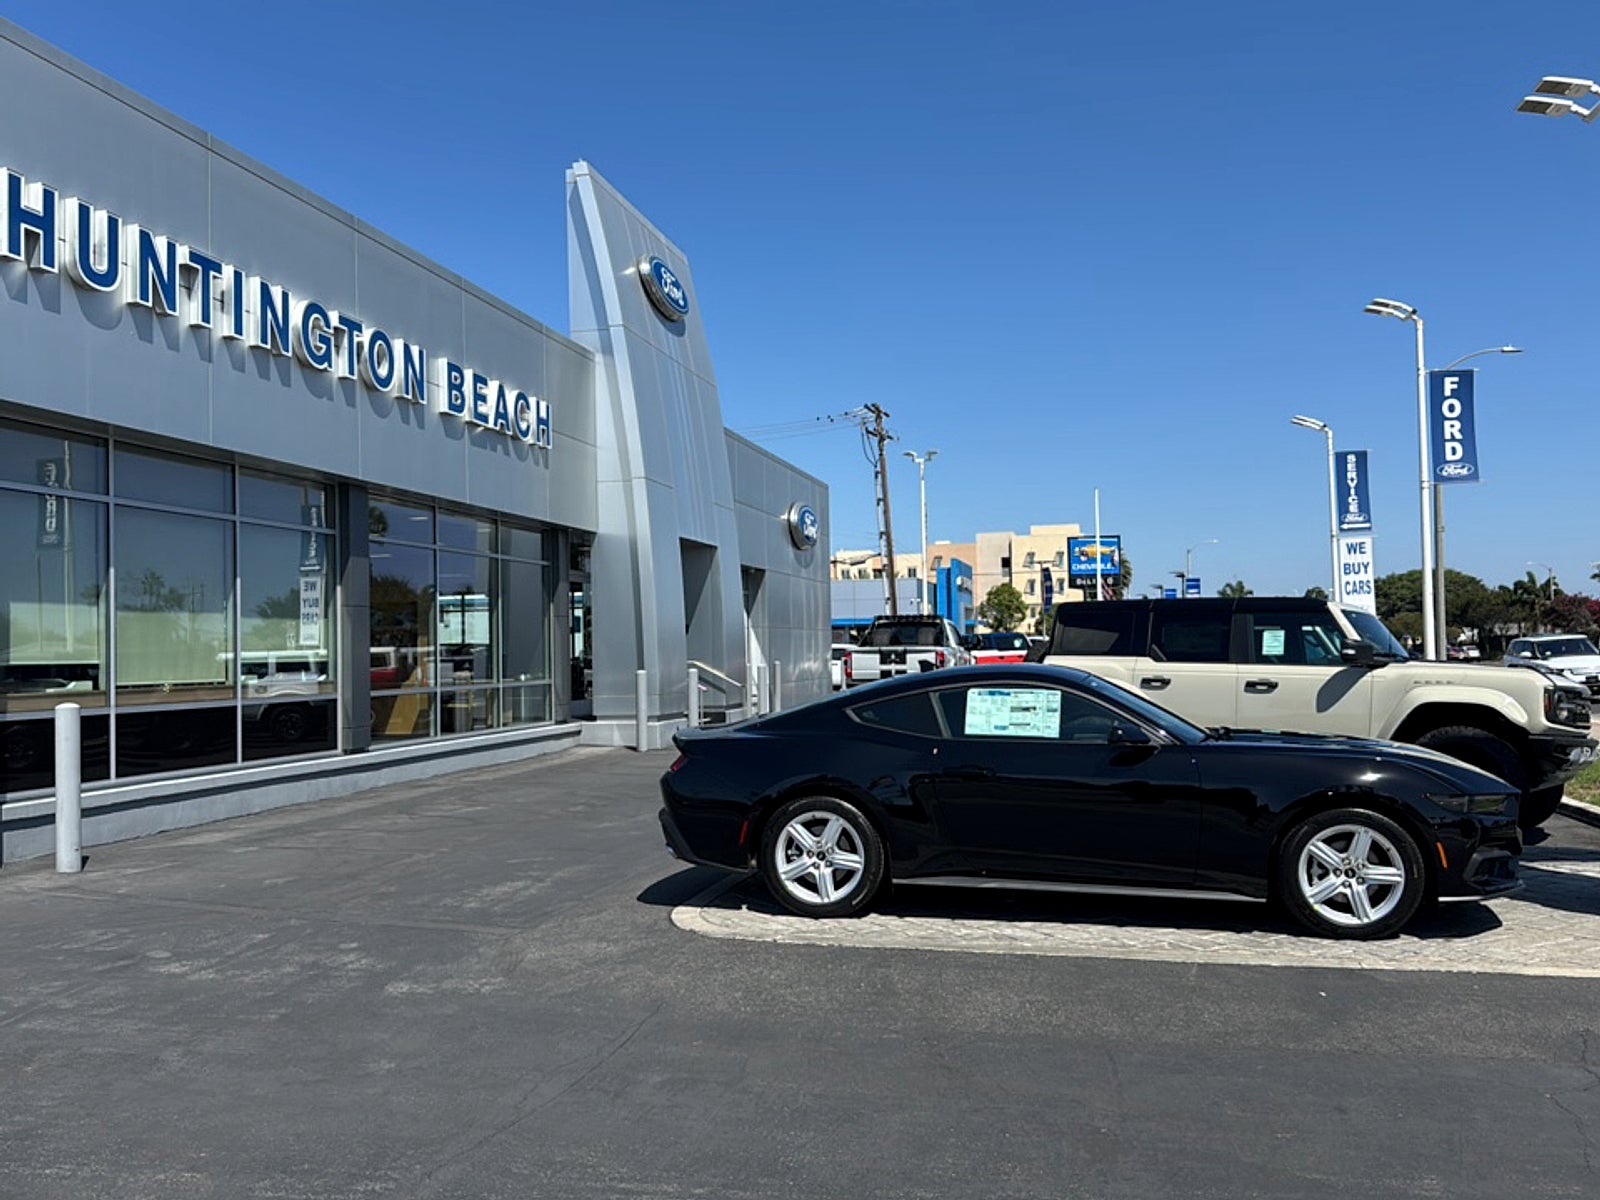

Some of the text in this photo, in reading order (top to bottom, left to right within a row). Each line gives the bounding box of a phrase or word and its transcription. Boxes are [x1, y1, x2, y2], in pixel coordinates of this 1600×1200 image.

[1, 167, 552, 450] HUNTINGTON BEACH
[1442, 376, 1463, 462] FORD
[1441, 464, 1469, 477] Ford
[1346, 454, 1359, 513] SERVICE
[1346, 542, 1367, 555] WE
[1343, 562, 1370, 575] BUY
[1345, 580, 1373, 596] CARS
